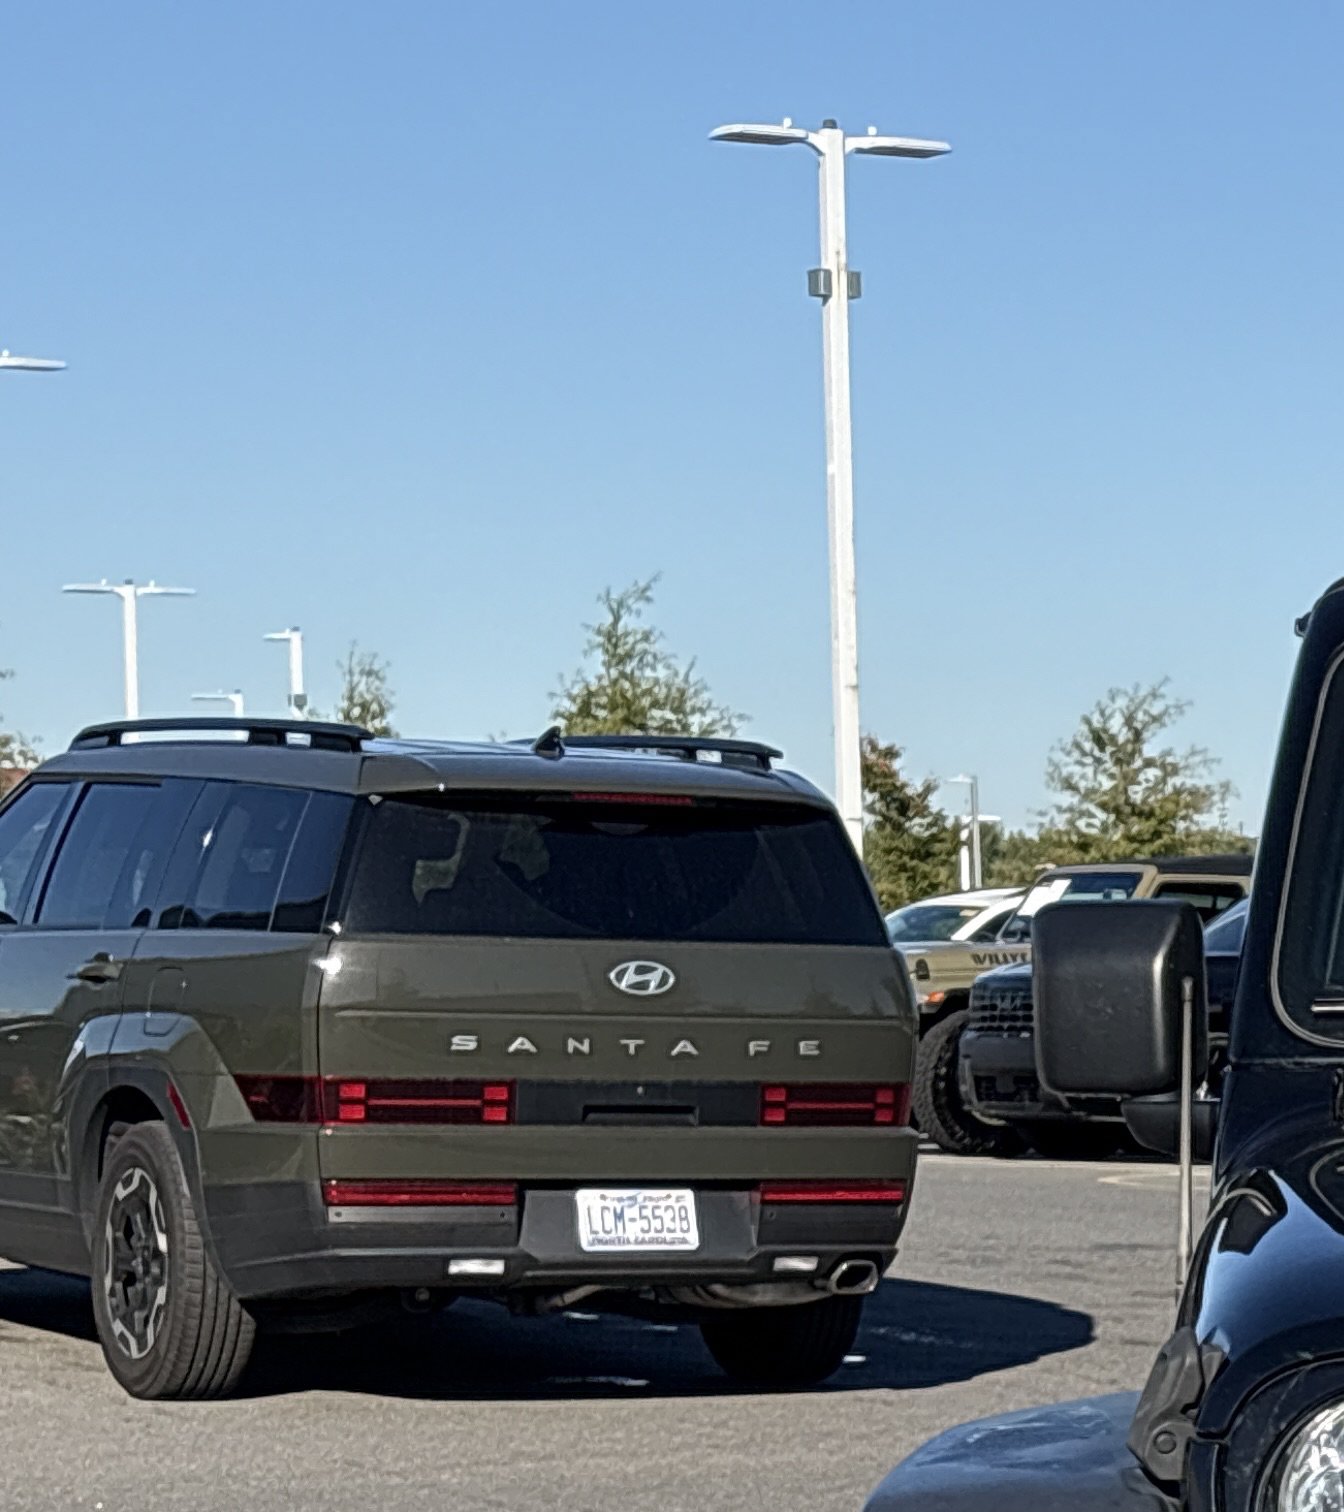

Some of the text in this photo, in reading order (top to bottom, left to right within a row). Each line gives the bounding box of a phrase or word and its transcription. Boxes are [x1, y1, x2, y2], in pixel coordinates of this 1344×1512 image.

[450, 1034, 822, 1057] SANTA FE
[587, 1204, 691, 1235] LCM-5538
